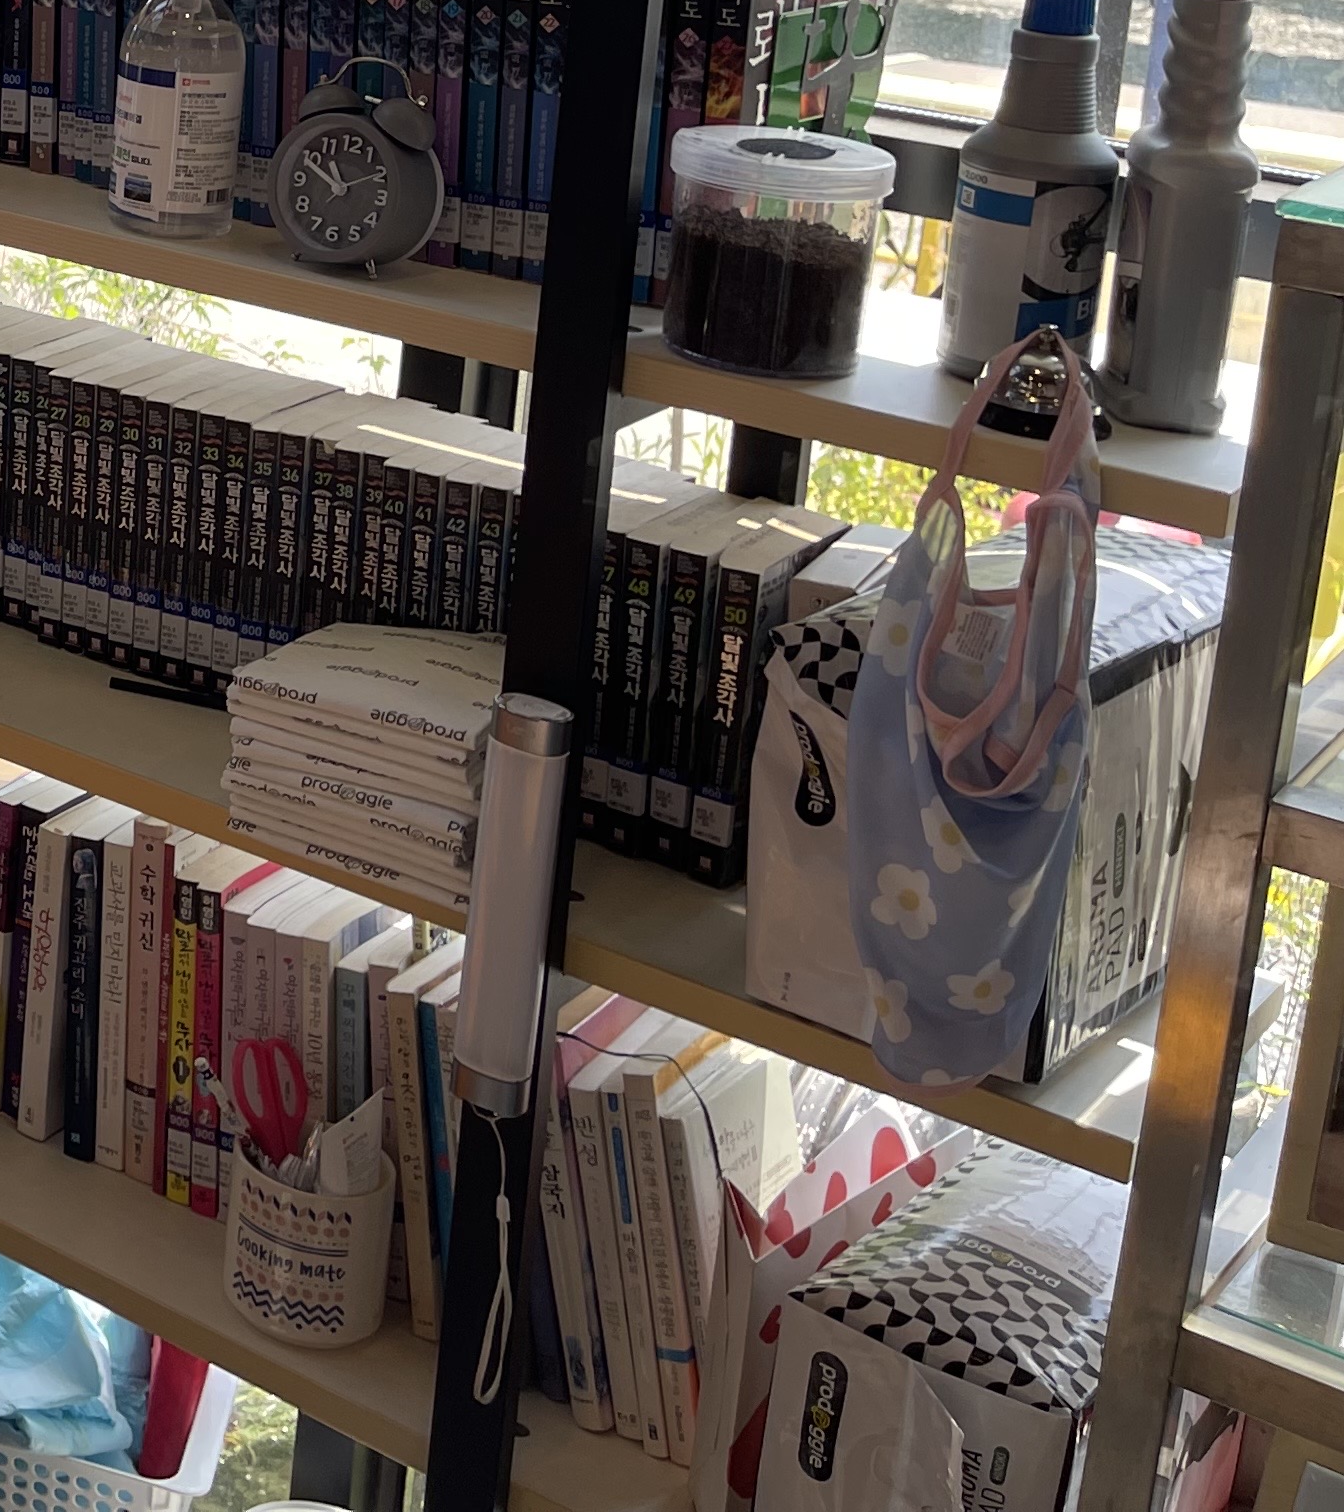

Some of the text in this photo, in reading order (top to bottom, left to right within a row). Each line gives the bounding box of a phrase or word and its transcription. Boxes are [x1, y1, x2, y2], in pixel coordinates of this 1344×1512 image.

[322, 137, 337, 155] 11
[343, 134, 363, 155] 12
[366, 146, 374, 163] 1
[294, 171, 306, 187] 9
[373, 165, 387, 183] 2
[295, 195, 310, 213] 8
[374, 189, 388, 206] 3
[311, 216, 322, 231] 7
[363, 211, 378, 228] 4
[325, 226, 339, 242] 6
[348, 225, 361, 242] 5
[122, 427, 138, 441] 30
[175, 442, 192, 456] 32
[628, 578, 649, 596] 48
[724, 606, 747, 625] 50
[137, 864, 157, 952] 수학 귀신
[1105, 906, 1125, 986] PAD
[70, 896, 91, 1020] 진주 귀고리 소녀
[237, 1226, 346, 1283] Cooking mate
